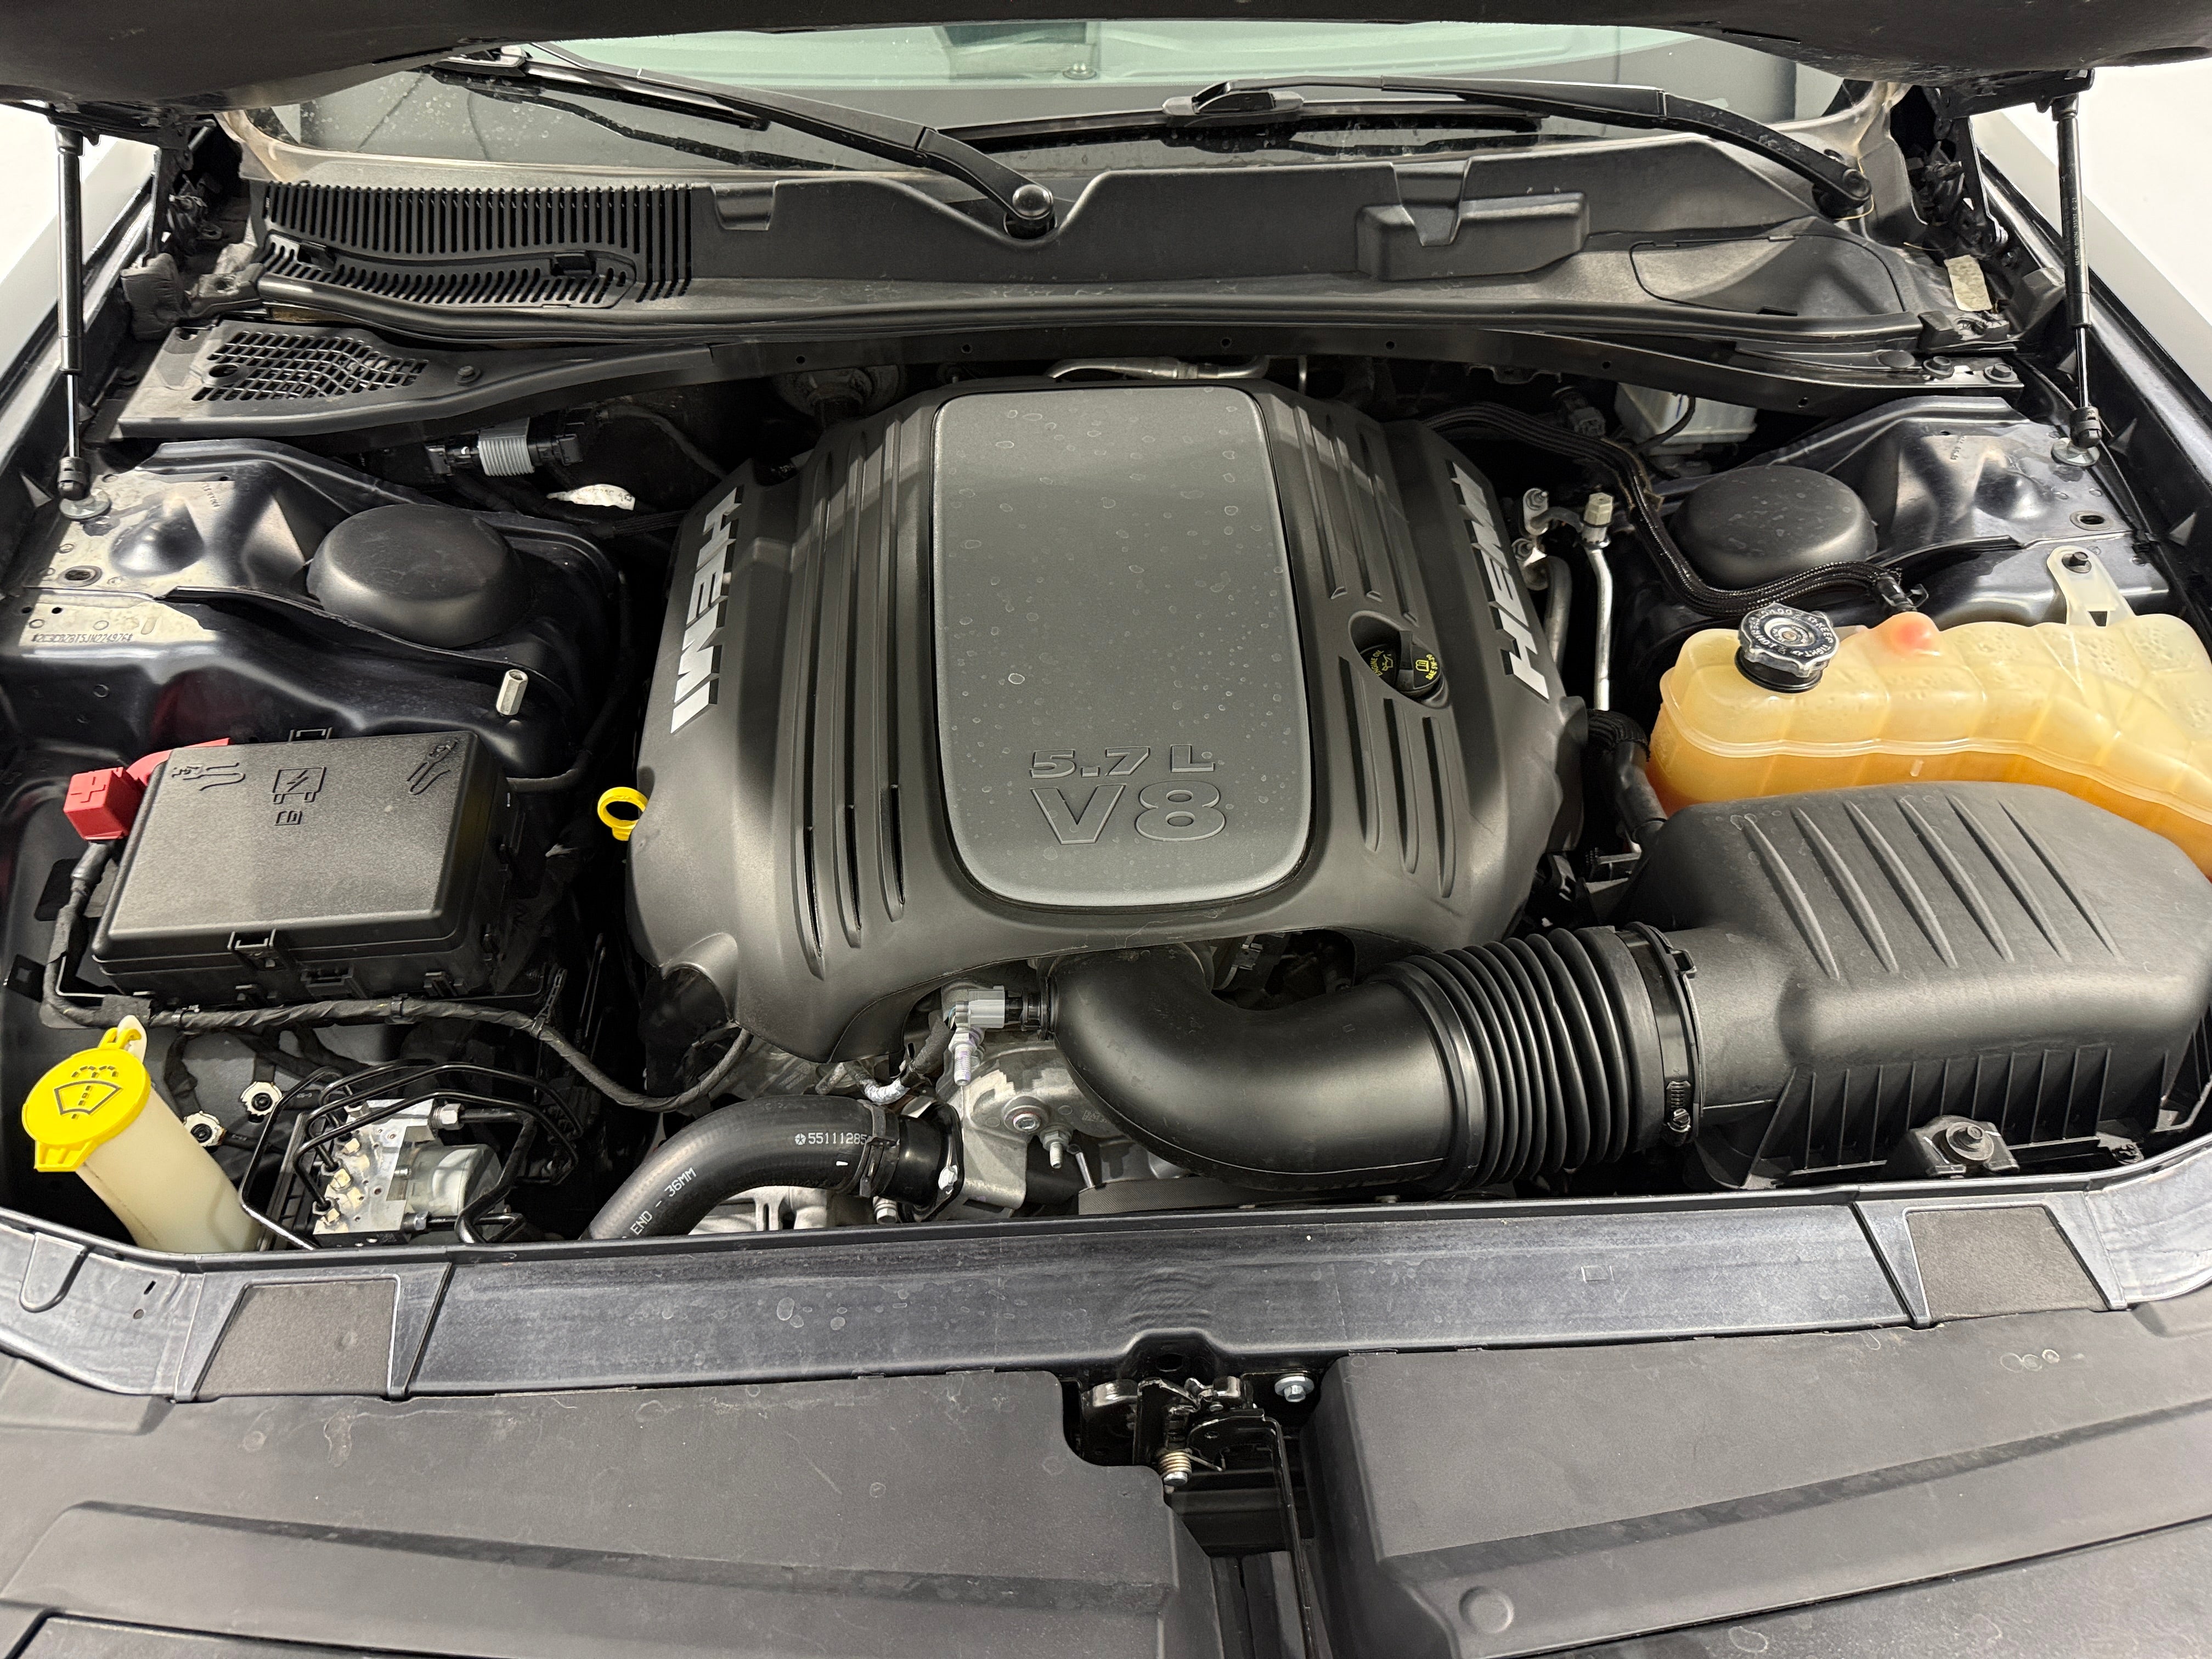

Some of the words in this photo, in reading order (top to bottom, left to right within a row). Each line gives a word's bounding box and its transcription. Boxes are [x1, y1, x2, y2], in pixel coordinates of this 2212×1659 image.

[1452, 461, 1549, 700] HEMI
[670, 487, 738, 734] HEMI
[1804, 644, 1832, 657] TIGHT
[1815, 622, 1835, 644] KEEP
[1370, 658, 1383, 676] ENGINE
[1029, 780, 1227, 845] V8
[808, 1132, 872, 1146] 55111285
[629, 1210, 653, 1235] END
[664, 1167, 697, 1198] 36MM
